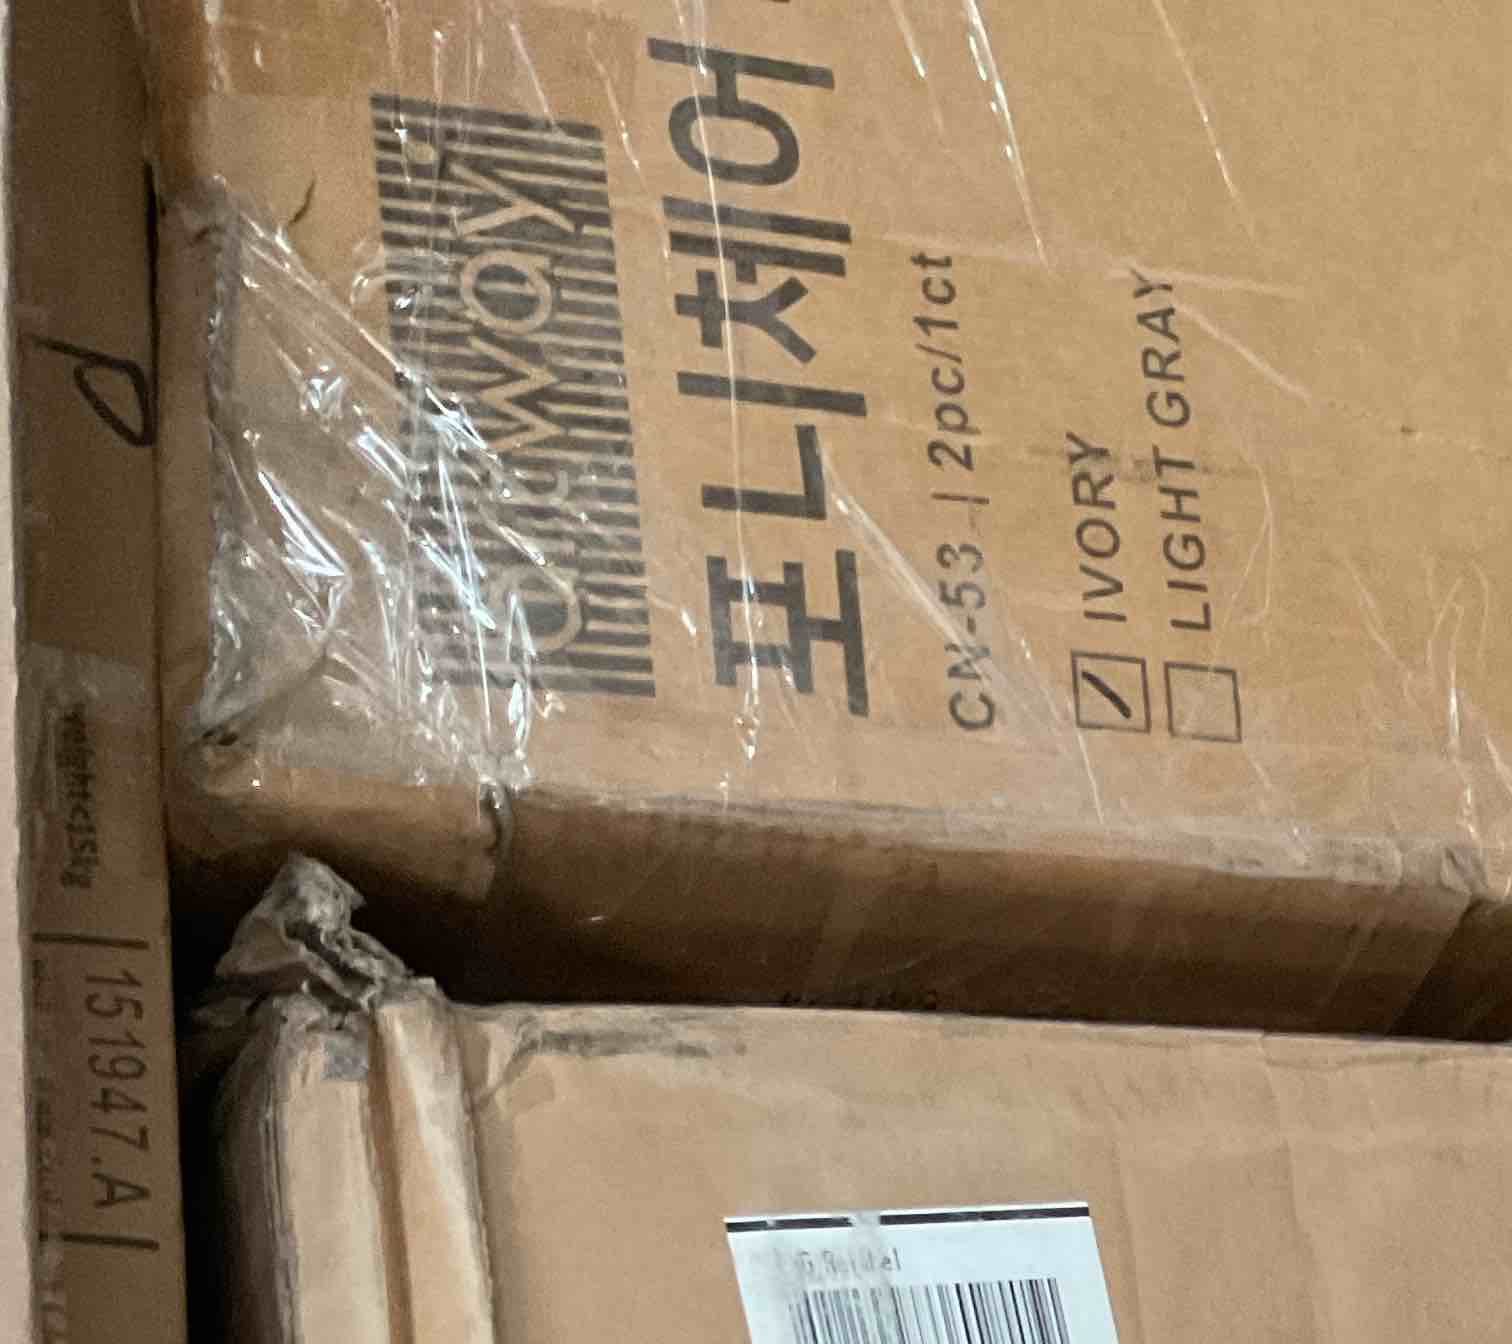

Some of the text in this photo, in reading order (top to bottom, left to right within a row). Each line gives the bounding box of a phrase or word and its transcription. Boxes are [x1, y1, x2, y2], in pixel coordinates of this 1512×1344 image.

[910, 252, 978, 475] 2pc/1ct
[1131, 266, 1213, 633] LIGHT GRAY
[929, 541, 998, 733] CN-53
[1068, 430, 1126, 626] IVORY
[85, 967, 151, 1209] 151947.A
